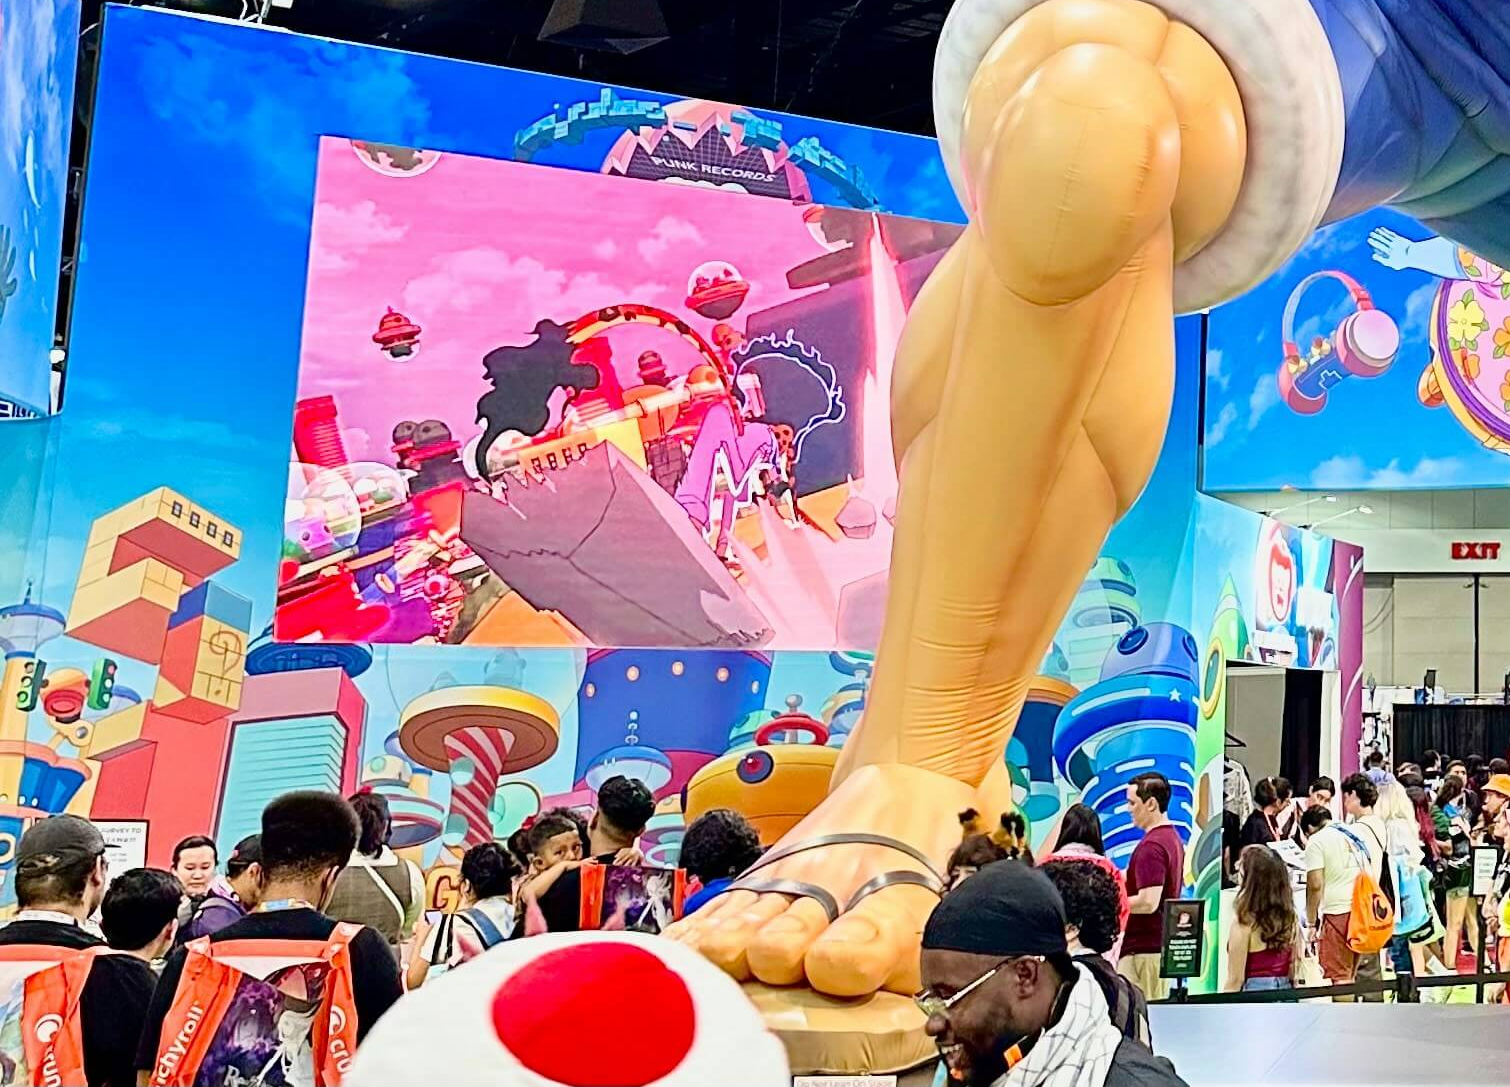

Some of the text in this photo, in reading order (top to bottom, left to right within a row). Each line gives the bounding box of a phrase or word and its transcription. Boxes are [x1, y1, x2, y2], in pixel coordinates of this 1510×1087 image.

[651, 156, 776, 182] PUNK RECORDS
[1451, 542, 1501, 560] EXIT
